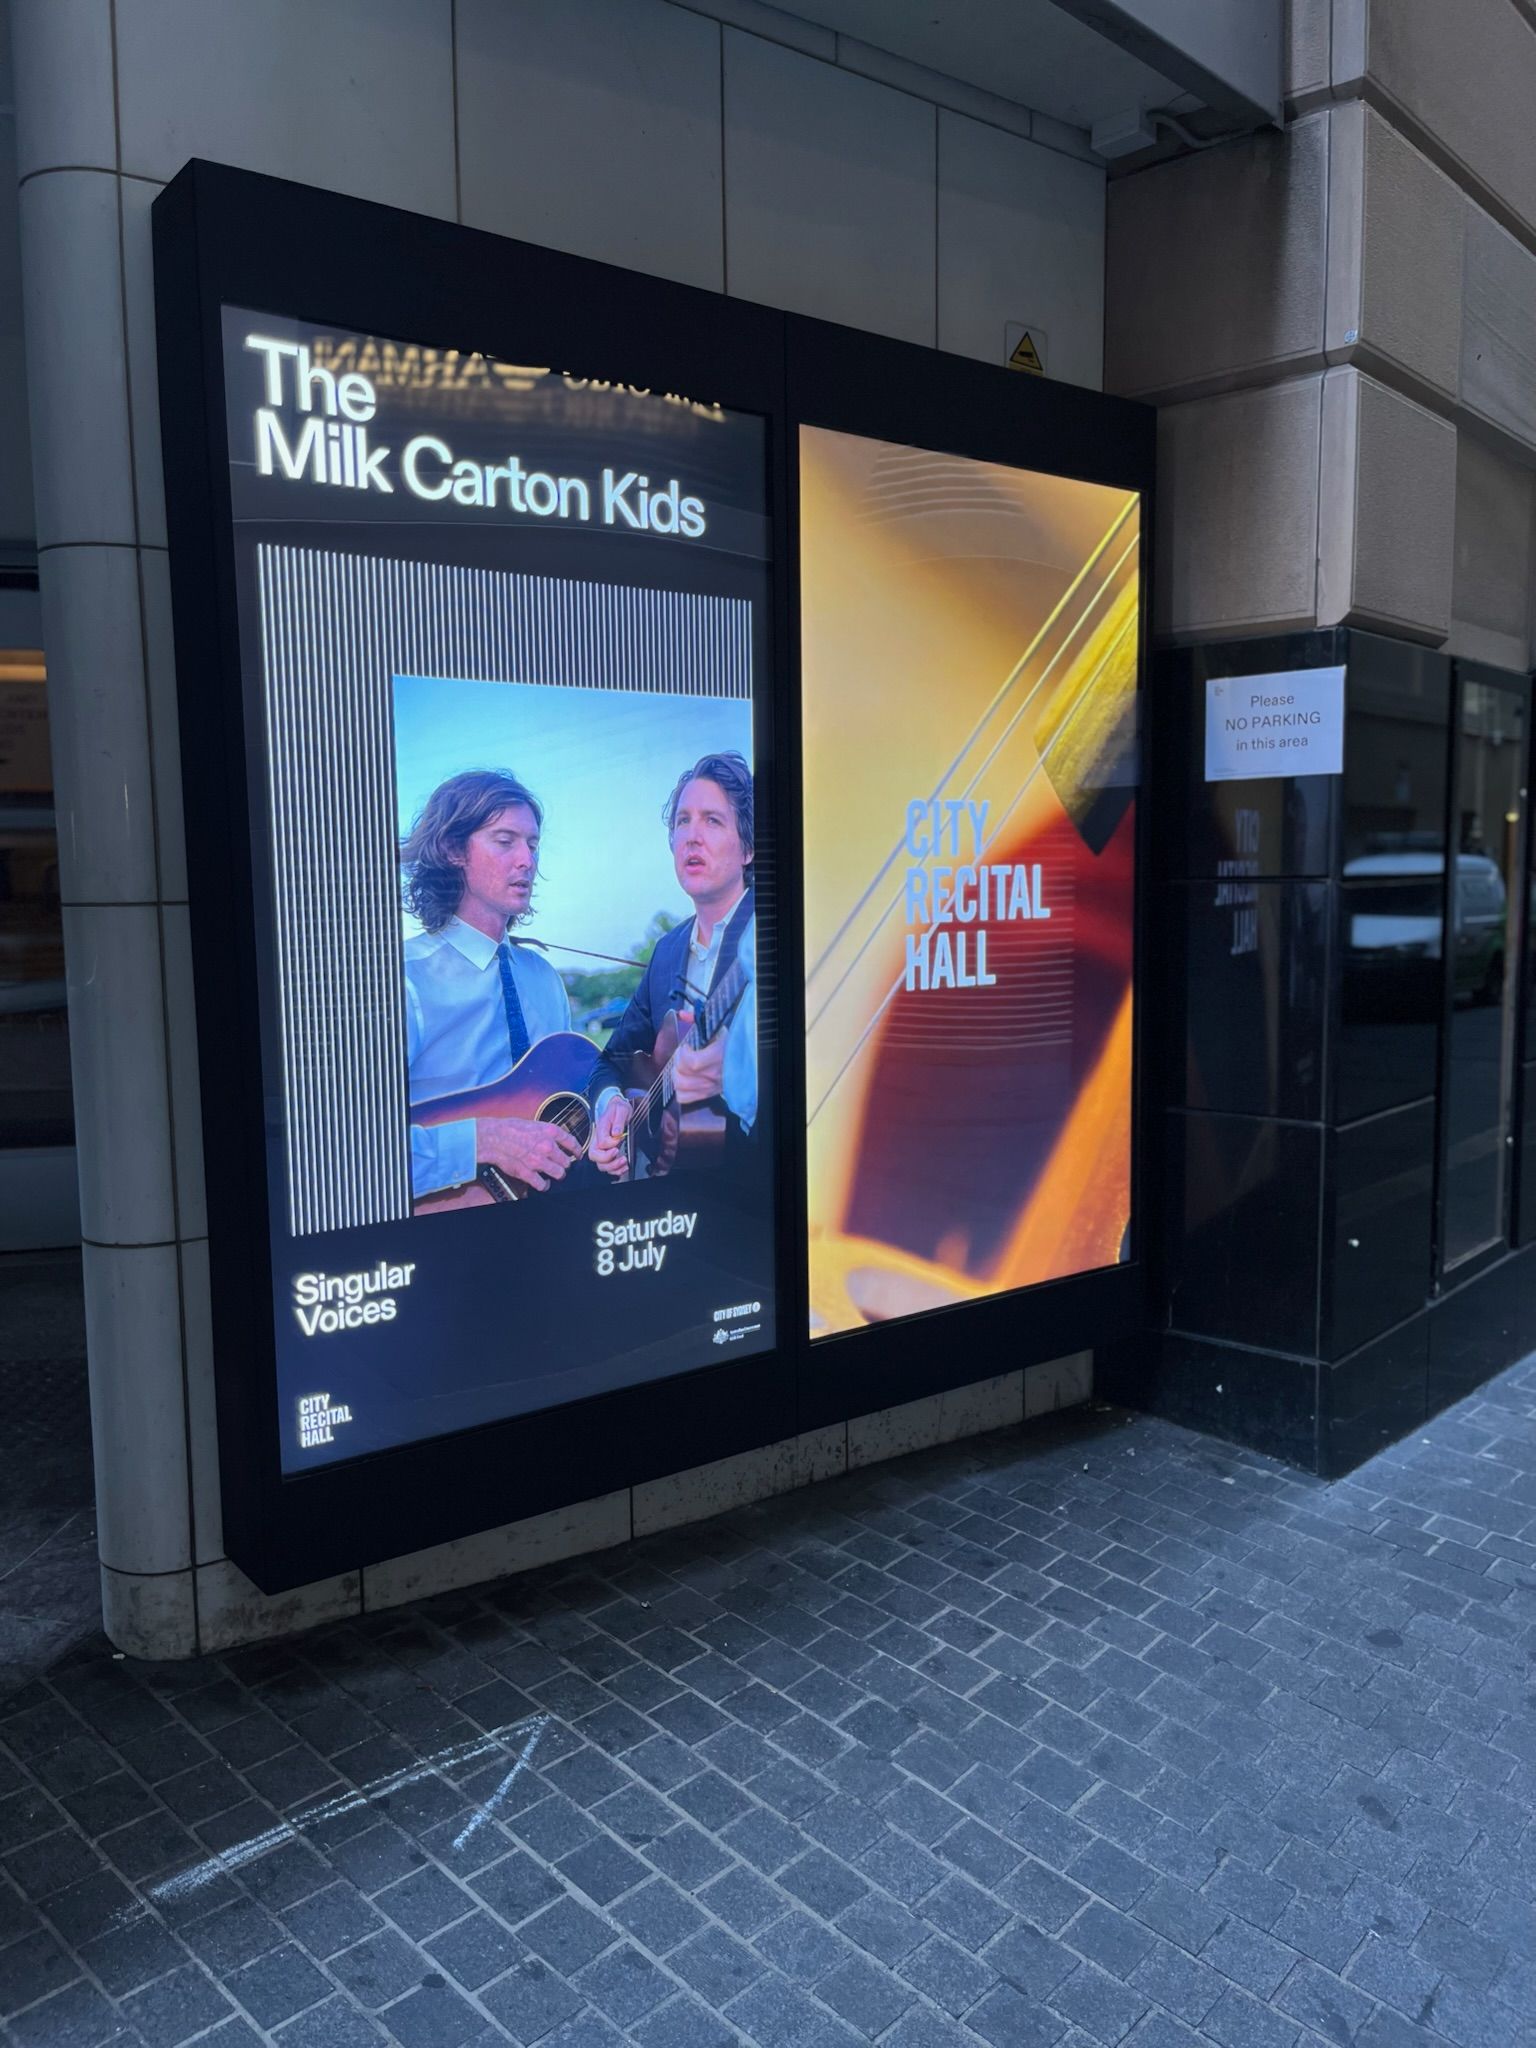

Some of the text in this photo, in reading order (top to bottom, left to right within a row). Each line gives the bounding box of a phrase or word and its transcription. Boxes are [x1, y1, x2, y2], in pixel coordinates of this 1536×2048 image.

[246, 334, 376, 422] The
[255, 408, 706, 537] Milk Carton Kids
[1250, 695, 1295, 708] Please
[1225, 711, 1321, 731] NO PARKING
[1236, 736, 1308, 751] in this area
[906, 797, 989, 857] CITY
[906, 864, 1051, 925] RECITAL
[906, 930, 997, 991] HALL
[596, 1210, 697, 1248] Saturday
[597, 1241, 666, 1276] 8 July
[296, 1261, 416, 1305] Singular
[296, 1298, 397, 1336] Voices
[300, 1393, 330, 1415] CITY
[300, 1405, 353, 1431] RECITAL
[301, 1426, 334, 1448] HALL
